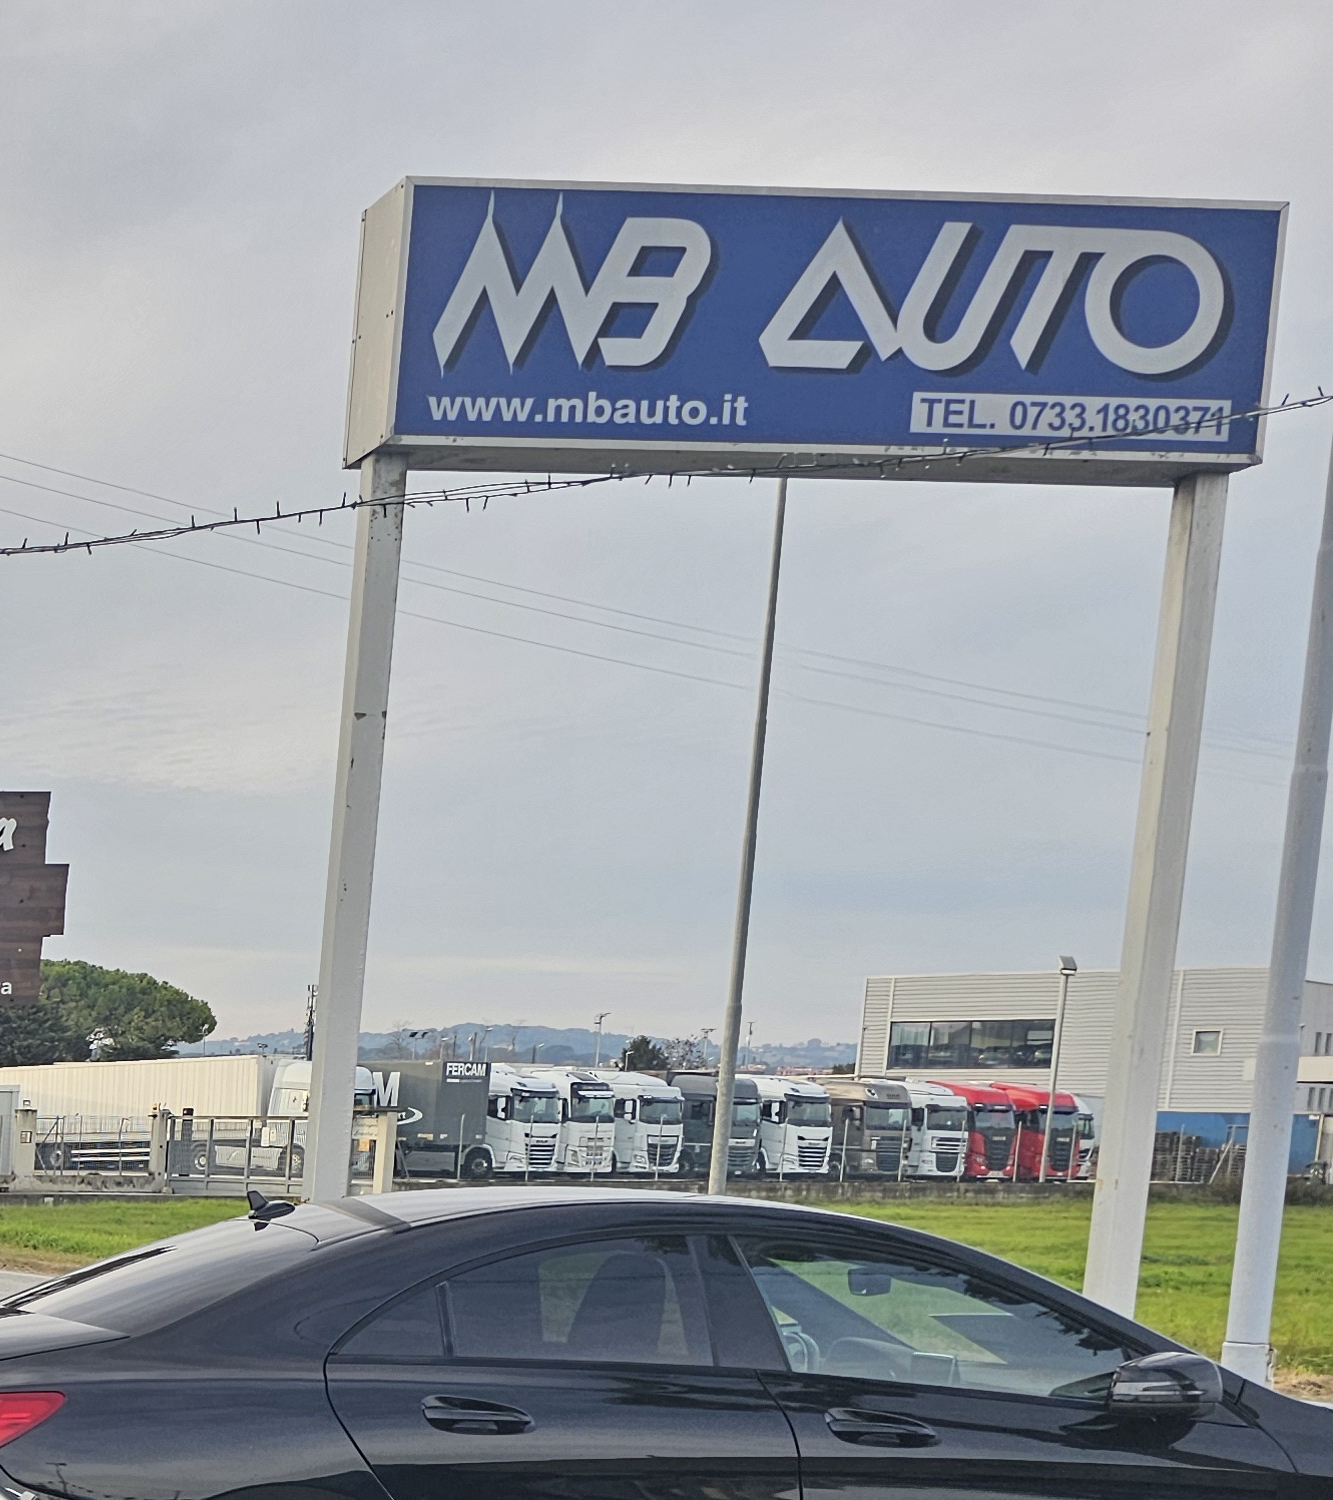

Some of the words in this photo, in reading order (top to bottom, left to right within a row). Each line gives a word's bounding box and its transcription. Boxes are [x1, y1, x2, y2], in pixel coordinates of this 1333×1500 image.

[432, 189, 713, 378] MB
[758, 216, 1225, 376] AUTO
[428, 391, 749, 427] www.mbauto.it
[919, 396, 997, 430] TEL.
[1008, 397, 1231, 435] 0733.1830371
[446, 1062, 487, 1077] FERCAM
